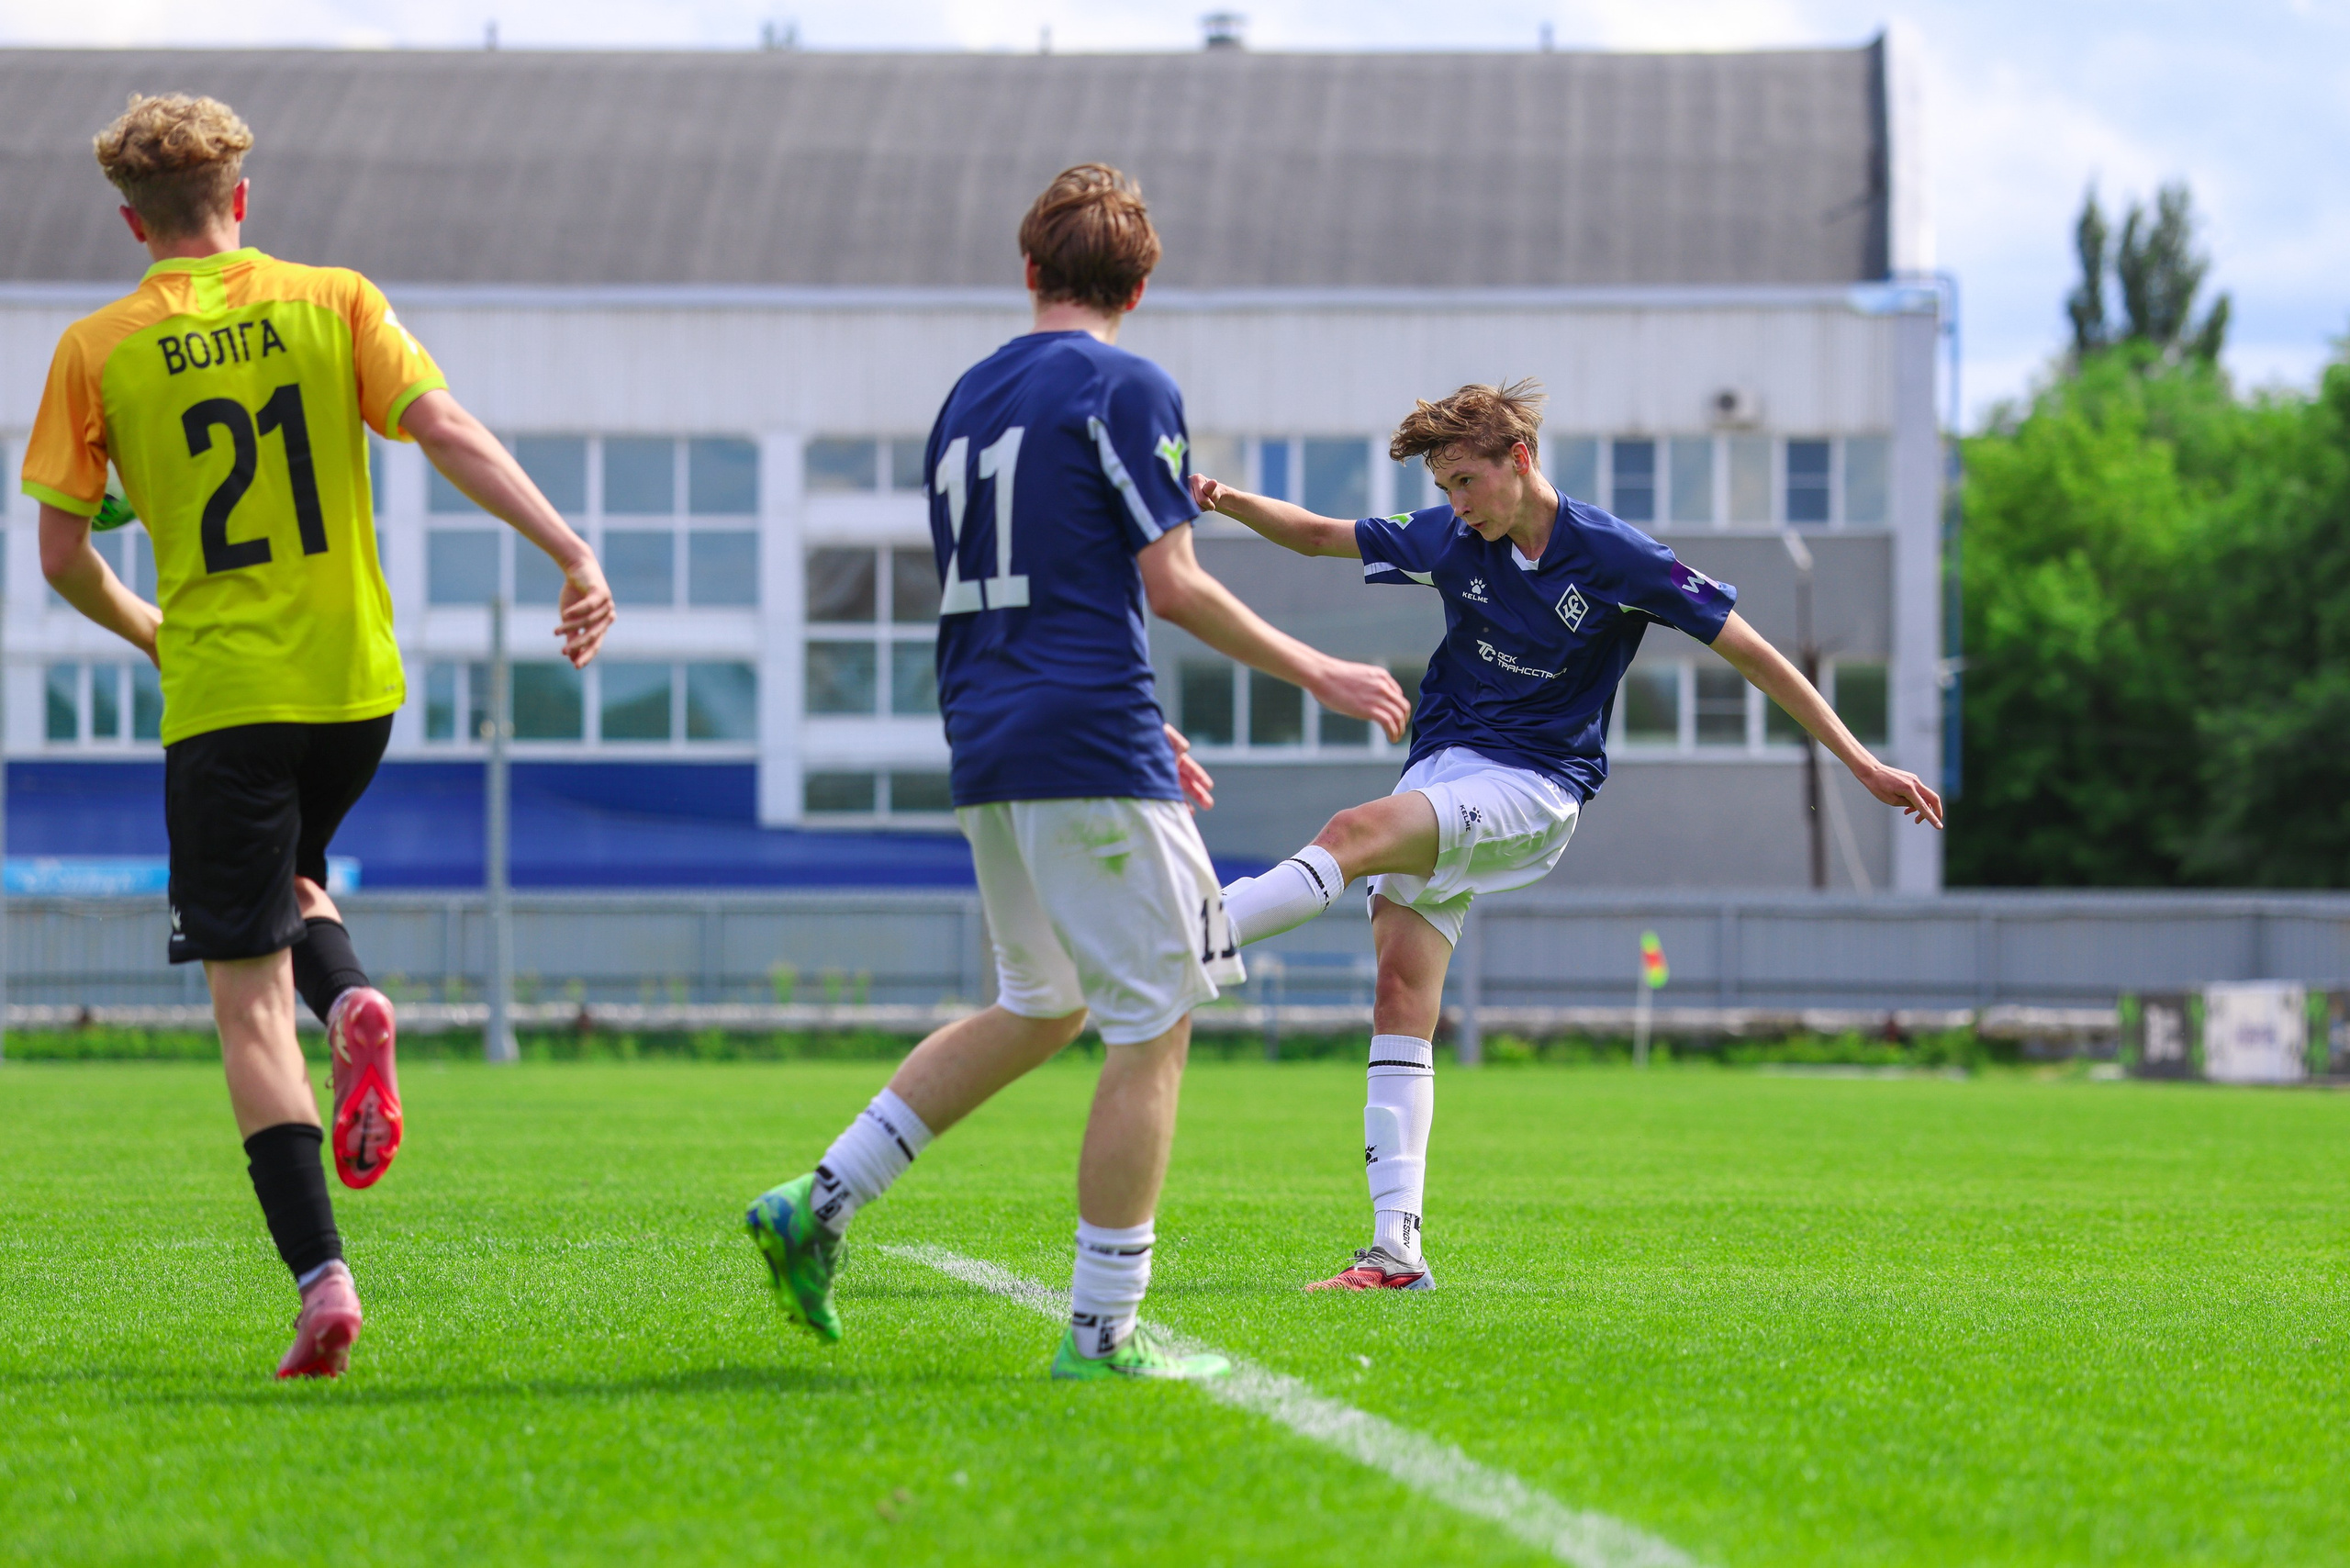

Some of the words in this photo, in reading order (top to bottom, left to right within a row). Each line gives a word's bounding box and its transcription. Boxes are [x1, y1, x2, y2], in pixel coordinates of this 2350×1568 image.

[158, 318, 286, 376] ВОЛГА
[181, 382, 329, 575] 21
[934, 426, 1031, 616] 11
[1461, 591, 1489, 604] KELME
[1459, 804, 1472, 833] KELME
